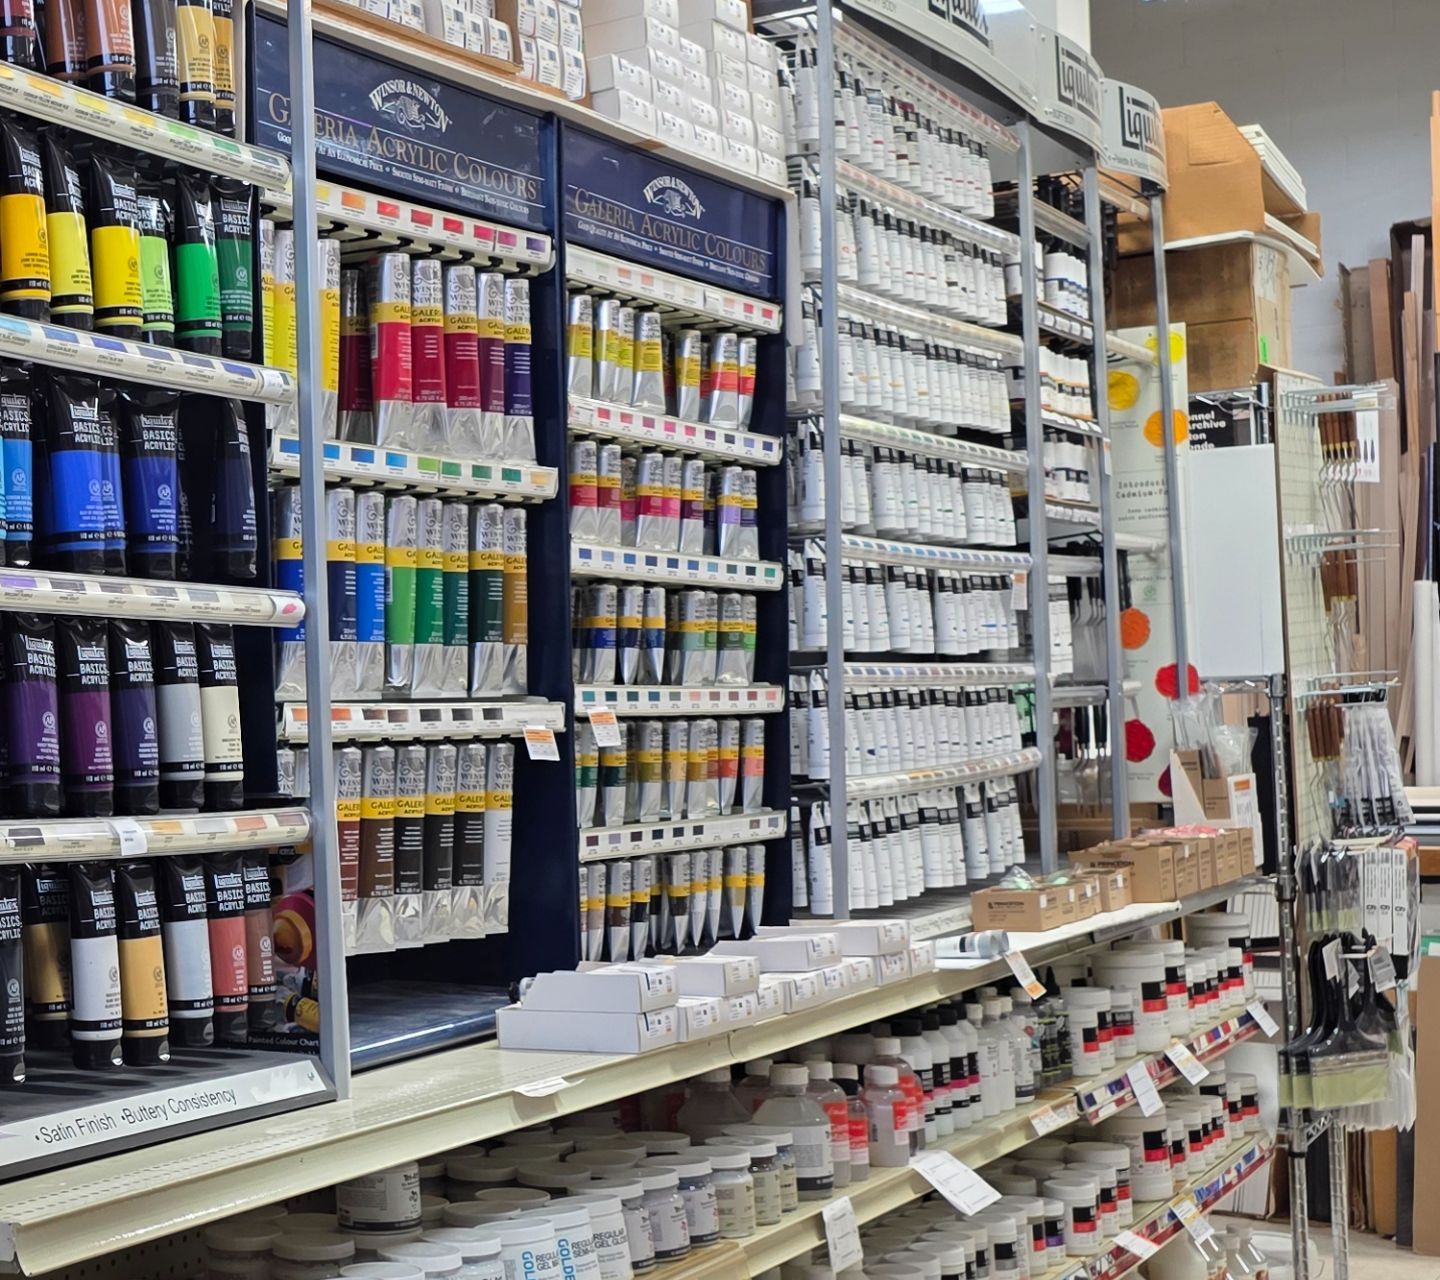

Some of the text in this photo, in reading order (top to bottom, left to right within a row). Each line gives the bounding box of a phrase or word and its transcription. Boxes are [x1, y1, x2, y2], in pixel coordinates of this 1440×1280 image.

[268, 91, 537, 200] GERIA ACRYLIC COLOURS
[1188, 418, 1226, 430] rchive
[299, 1037, 320, 1047] Chart
[39, 1087, 237, 1144] Satin Finish Buttery Consistency
